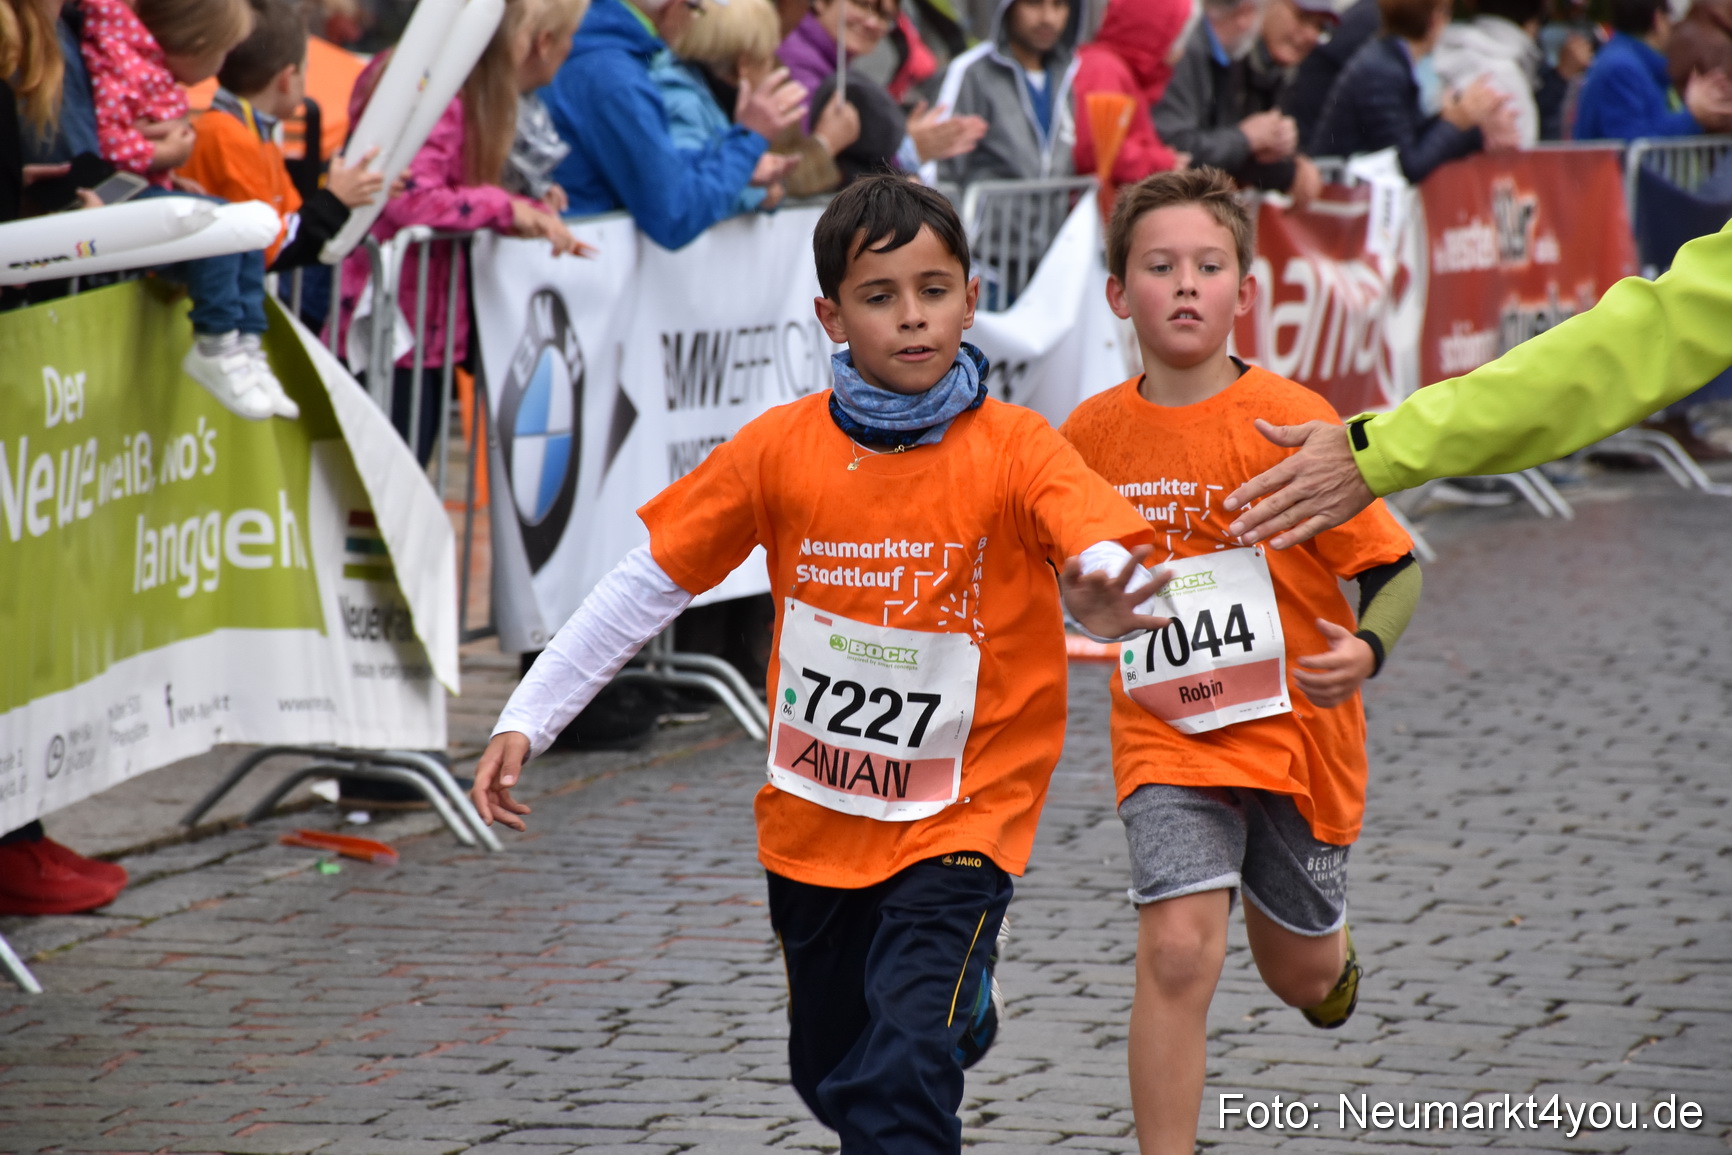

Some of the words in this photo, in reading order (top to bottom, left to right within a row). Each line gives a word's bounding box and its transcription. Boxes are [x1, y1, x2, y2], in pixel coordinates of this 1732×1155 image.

[43, 365, 86, 429] Der
[0, 434, 98, 543] Neue
[1113, 477, 1198, 497] umarkter
[799, 538, 934, 559] Neumarkter
[796, 564, 905, 591] Stadtlauf
[1156, 571, 1216, 597] OCK
[1145, 603, 1255, 673] 7044
[848, 639, 919, 665] BOCK
[1126, 671, 1137, 681] B6
[1179, 680, 1224, 704] Robin
[802, 667, 942, 748] 7227
[791, 738, 912, 799] ANIAN
[956, 856, 982, 868] JAKO
